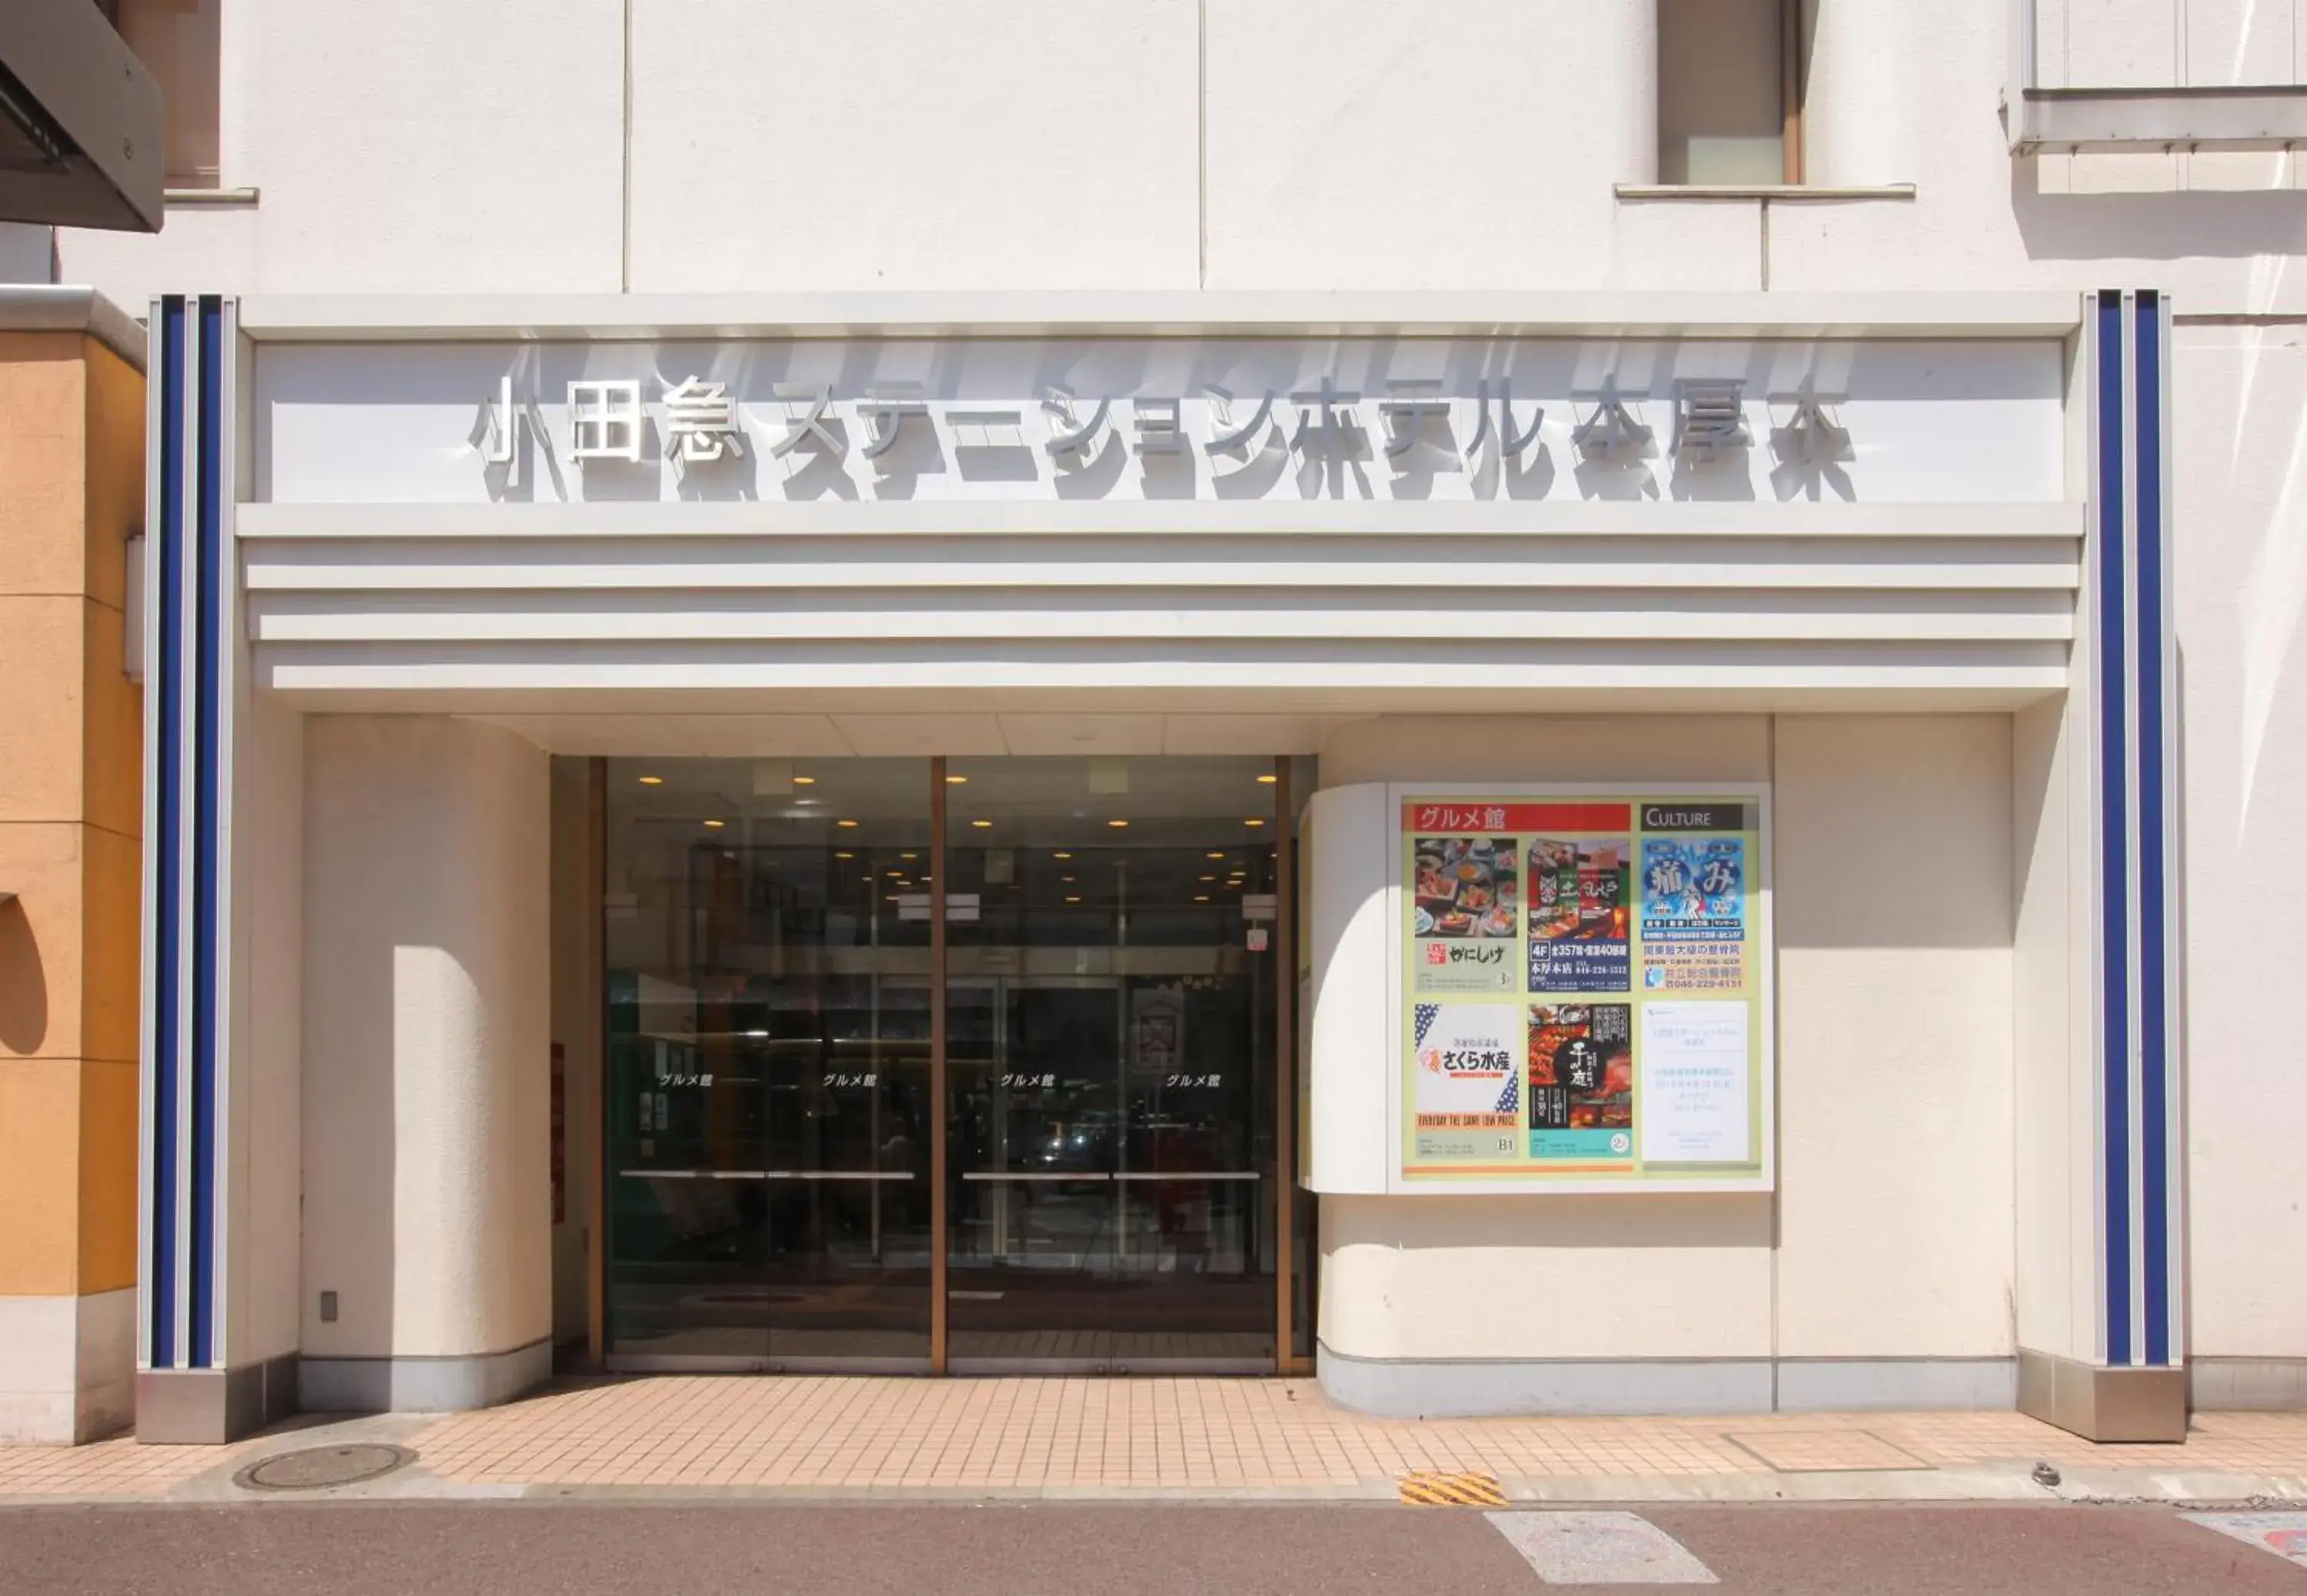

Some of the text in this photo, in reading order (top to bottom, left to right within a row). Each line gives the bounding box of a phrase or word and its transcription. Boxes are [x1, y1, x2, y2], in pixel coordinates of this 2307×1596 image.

[468, 374, 1849, 463] 小田急ステーションホテル本厚木
[1420, 807, 1506, 830] グルメ館
[1651, 860, 1736, 894] 痛み
[1443, 1050, 1510, 1070] さくら水産
[661, 1073, 714, 1087] グルメ館
[823, 1073, 877, 1087] グルメ館
[1000, 1073, 1055, 1087] グルメ館
[1166, 1074, 1221, 1087] グルメ館
